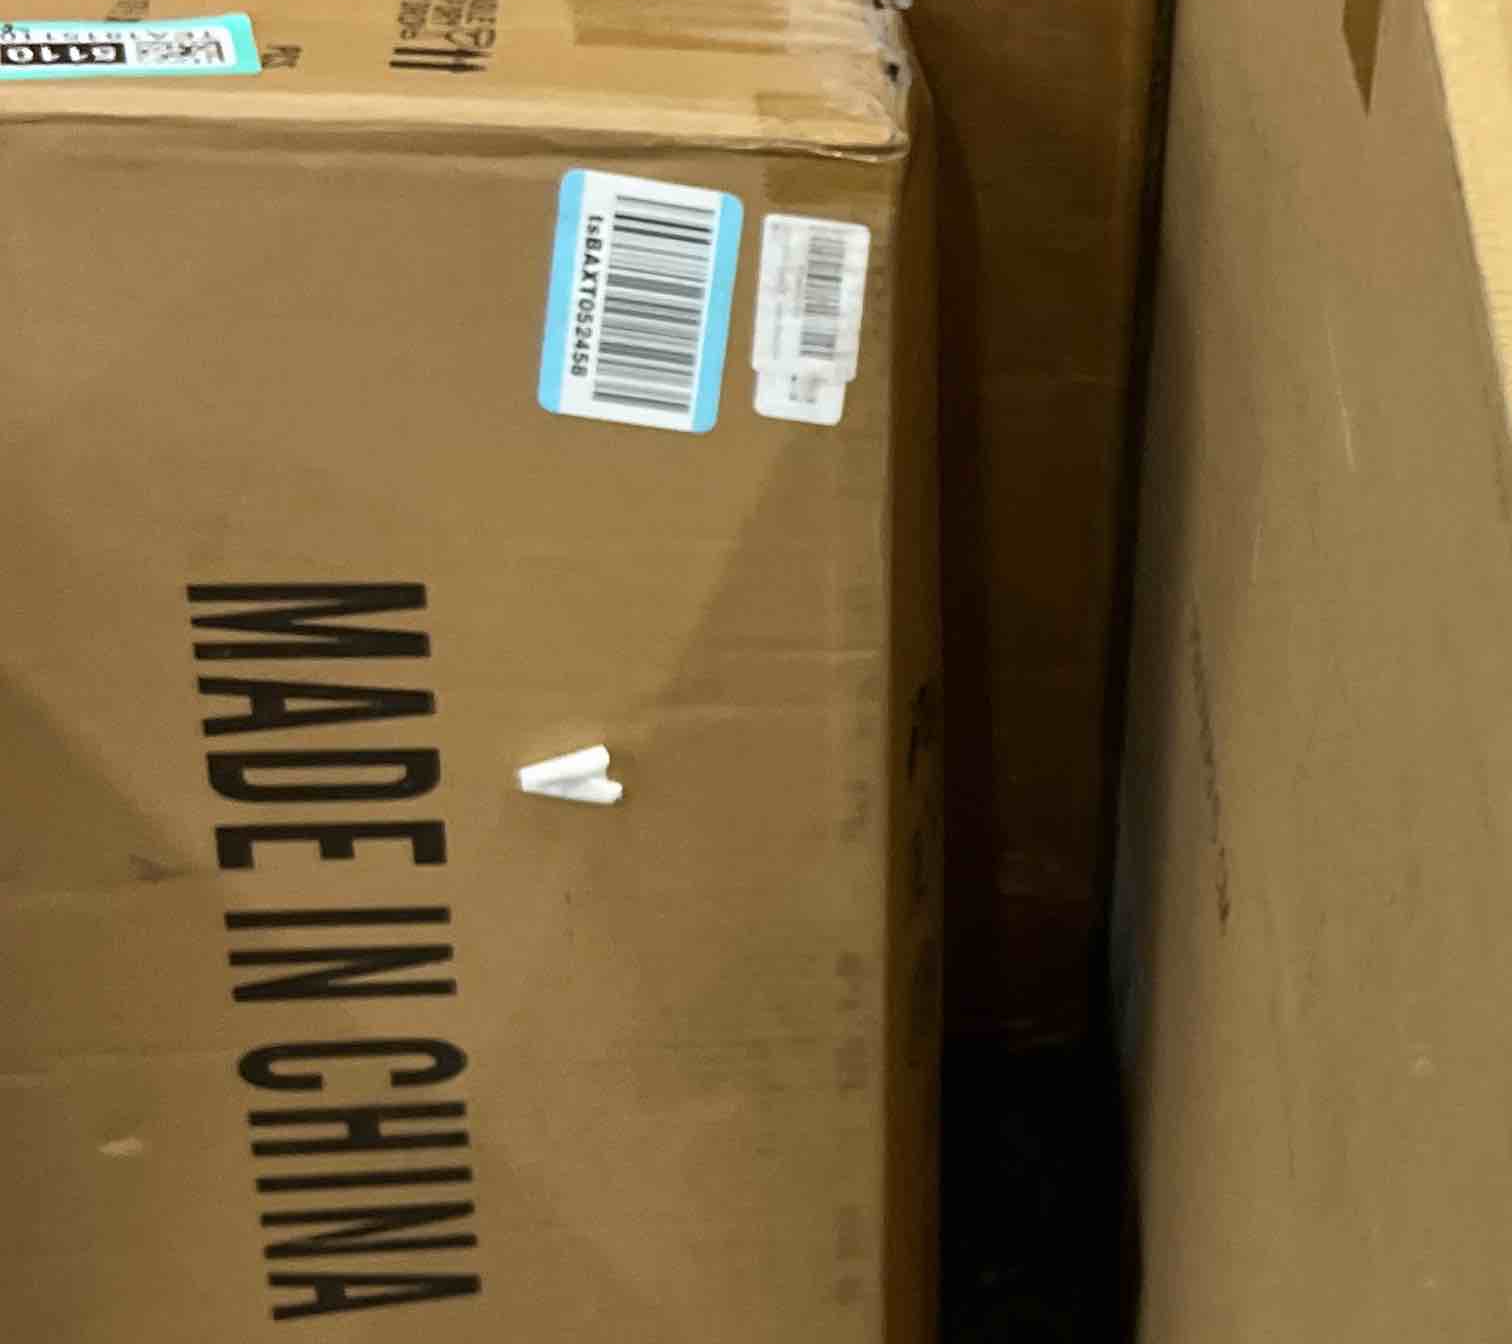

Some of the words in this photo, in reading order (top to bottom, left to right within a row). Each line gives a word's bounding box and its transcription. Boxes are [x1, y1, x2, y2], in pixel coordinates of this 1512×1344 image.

[187, 582, 448, 869] MADE
[224, 906, 457, 1003] IN
[238, 1037, 481, 1321] CHINA
